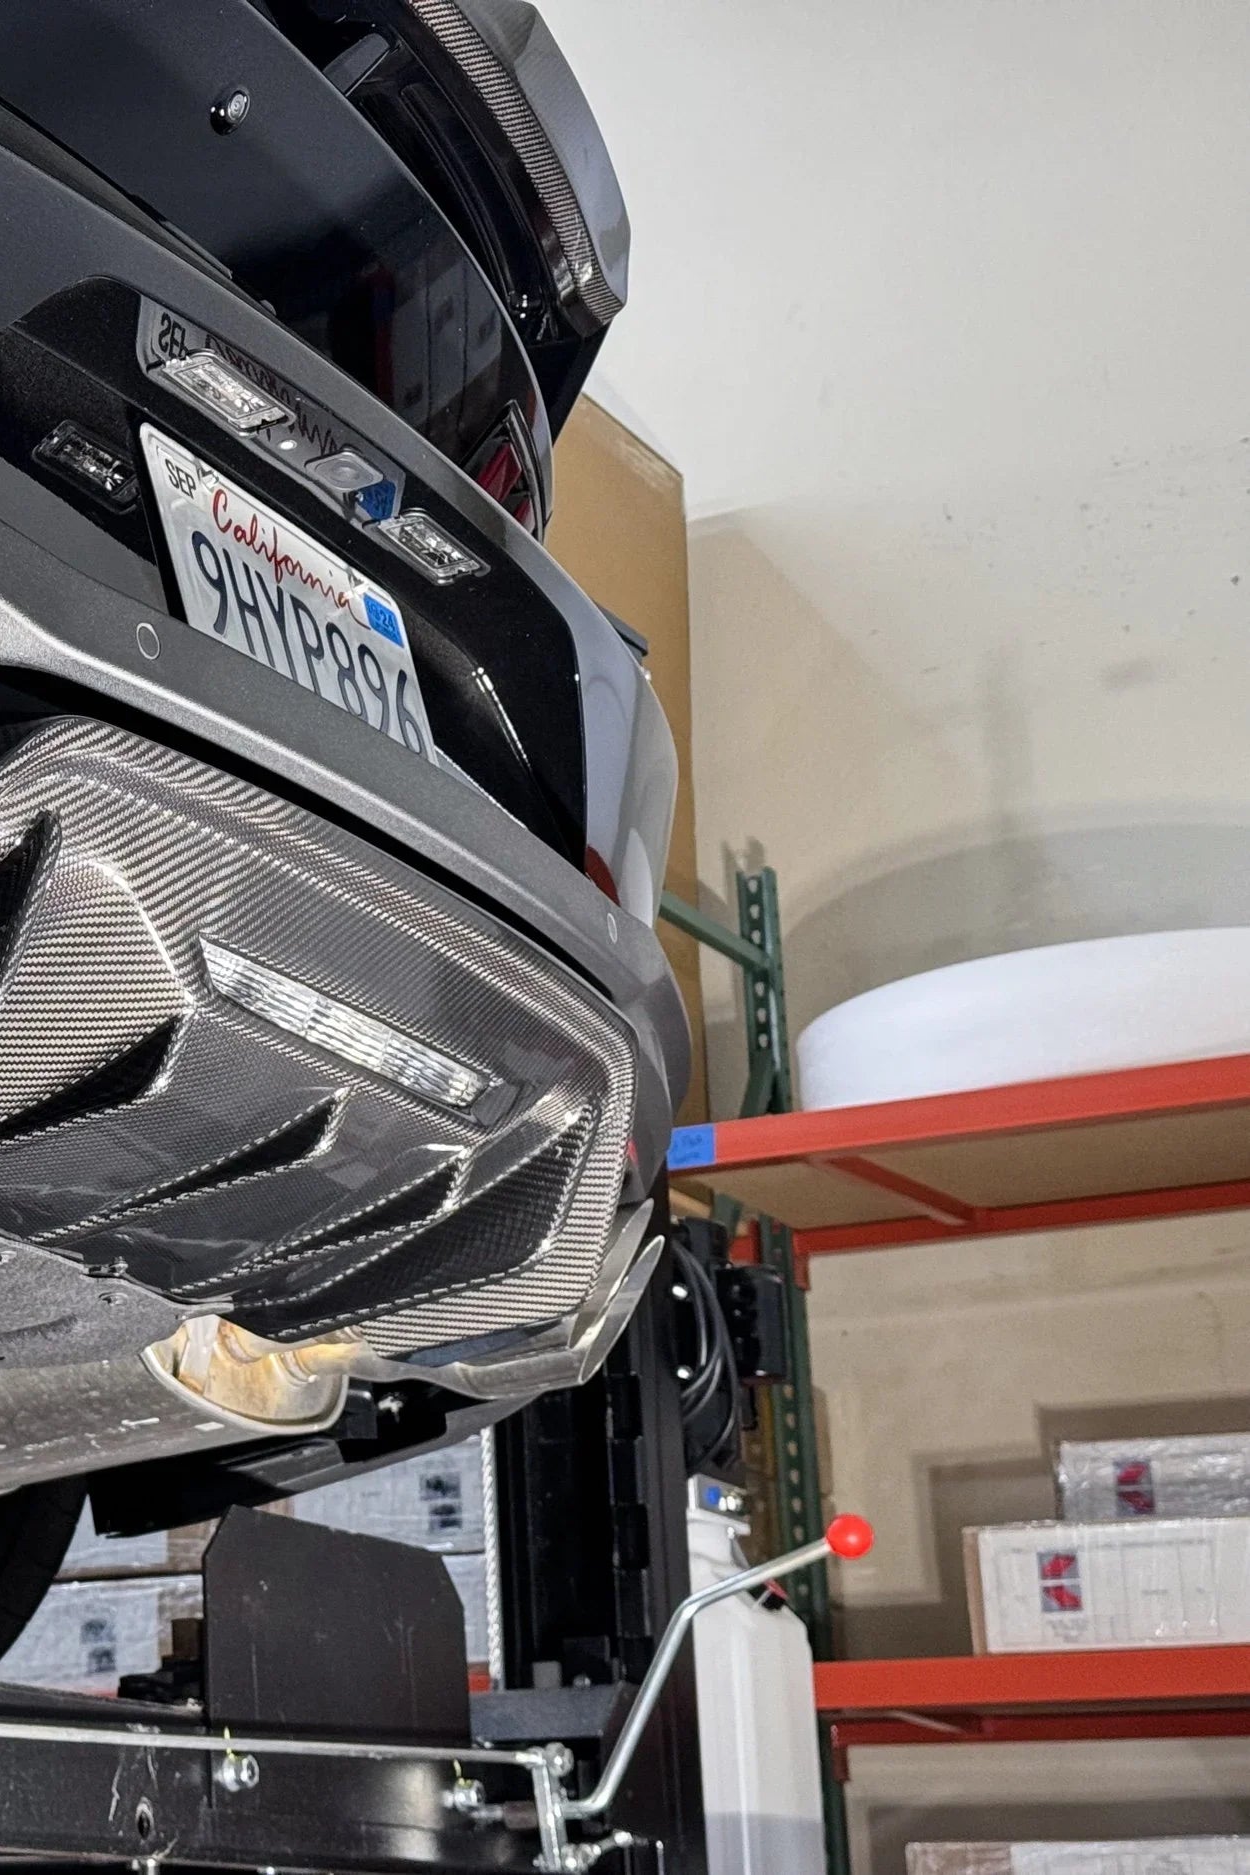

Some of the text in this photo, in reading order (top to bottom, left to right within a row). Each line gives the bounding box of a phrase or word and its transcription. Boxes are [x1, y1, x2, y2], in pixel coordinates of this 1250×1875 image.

[165, 458, 197, 499] SEP
[213, 489, 371, 630] California
[192, 531, 427, 755] 9HYP896
